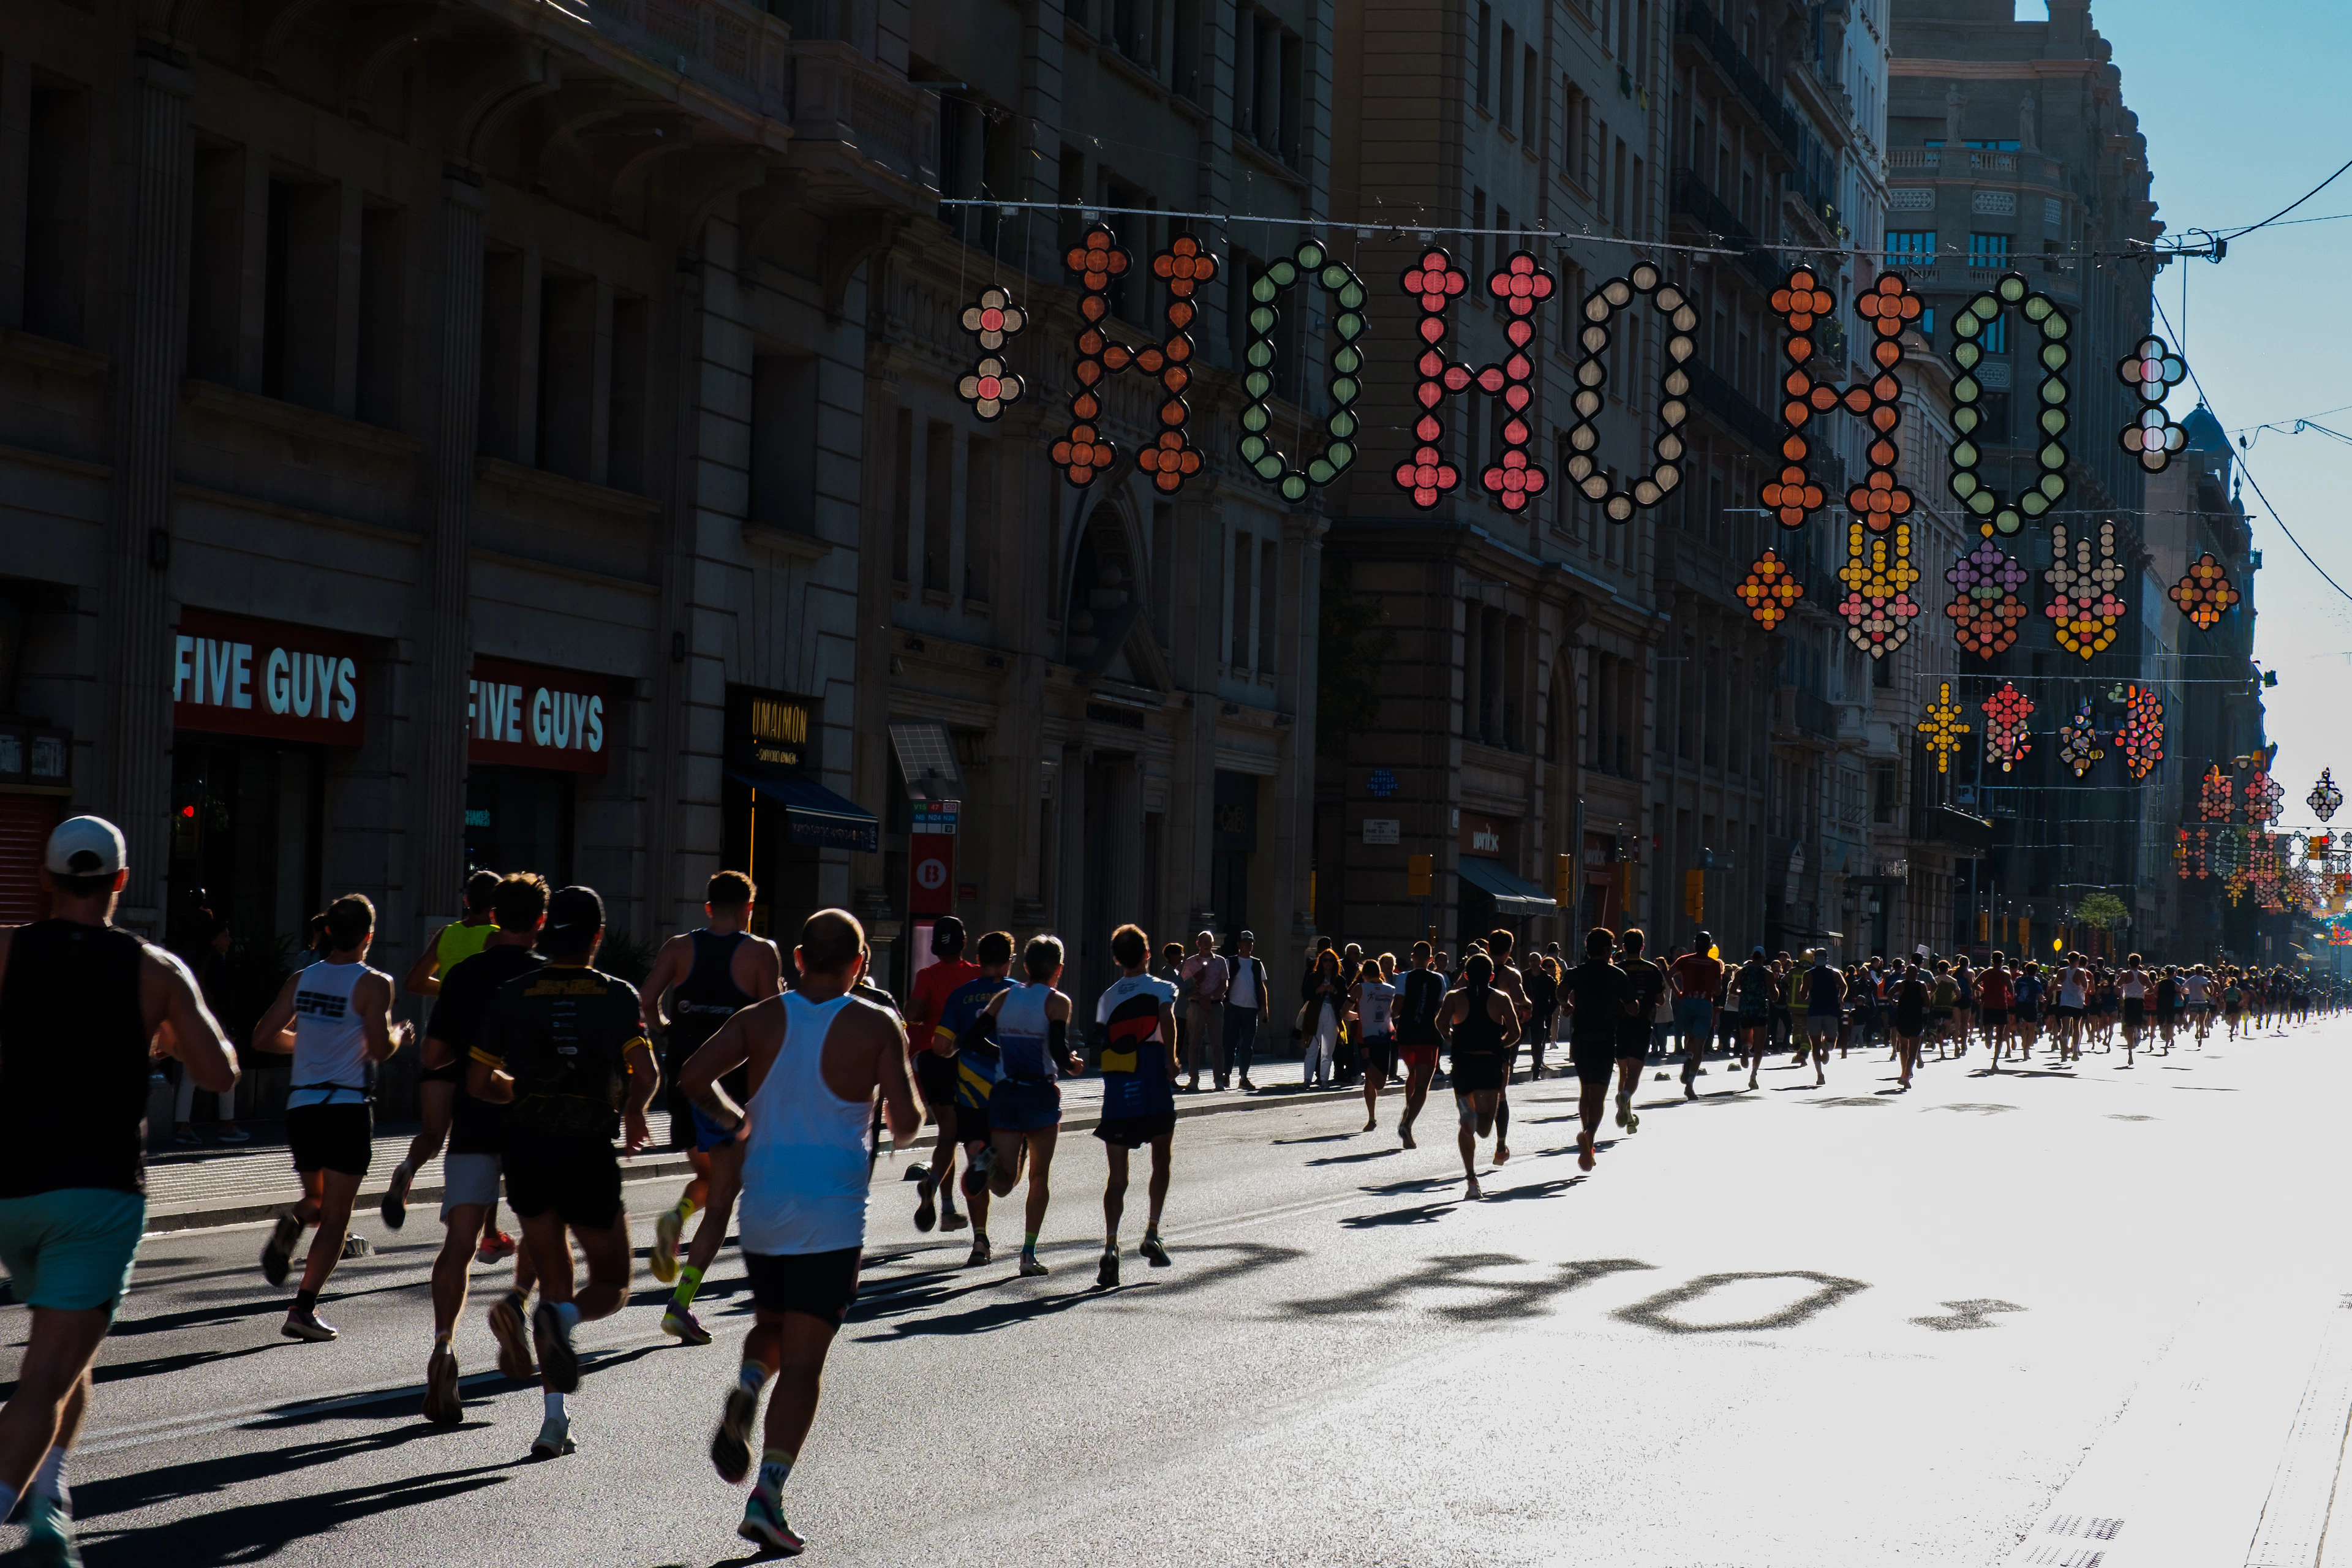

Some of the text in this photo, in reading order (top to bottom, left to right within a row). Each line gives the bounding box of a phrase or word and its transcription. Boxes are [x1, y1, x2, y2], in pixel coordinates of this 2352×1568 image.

[175, 635, 355, 722] FIVE GUYS
[533, 687, 603, 752] GUYS
[752, 698, 808, 745] UMAIMON
